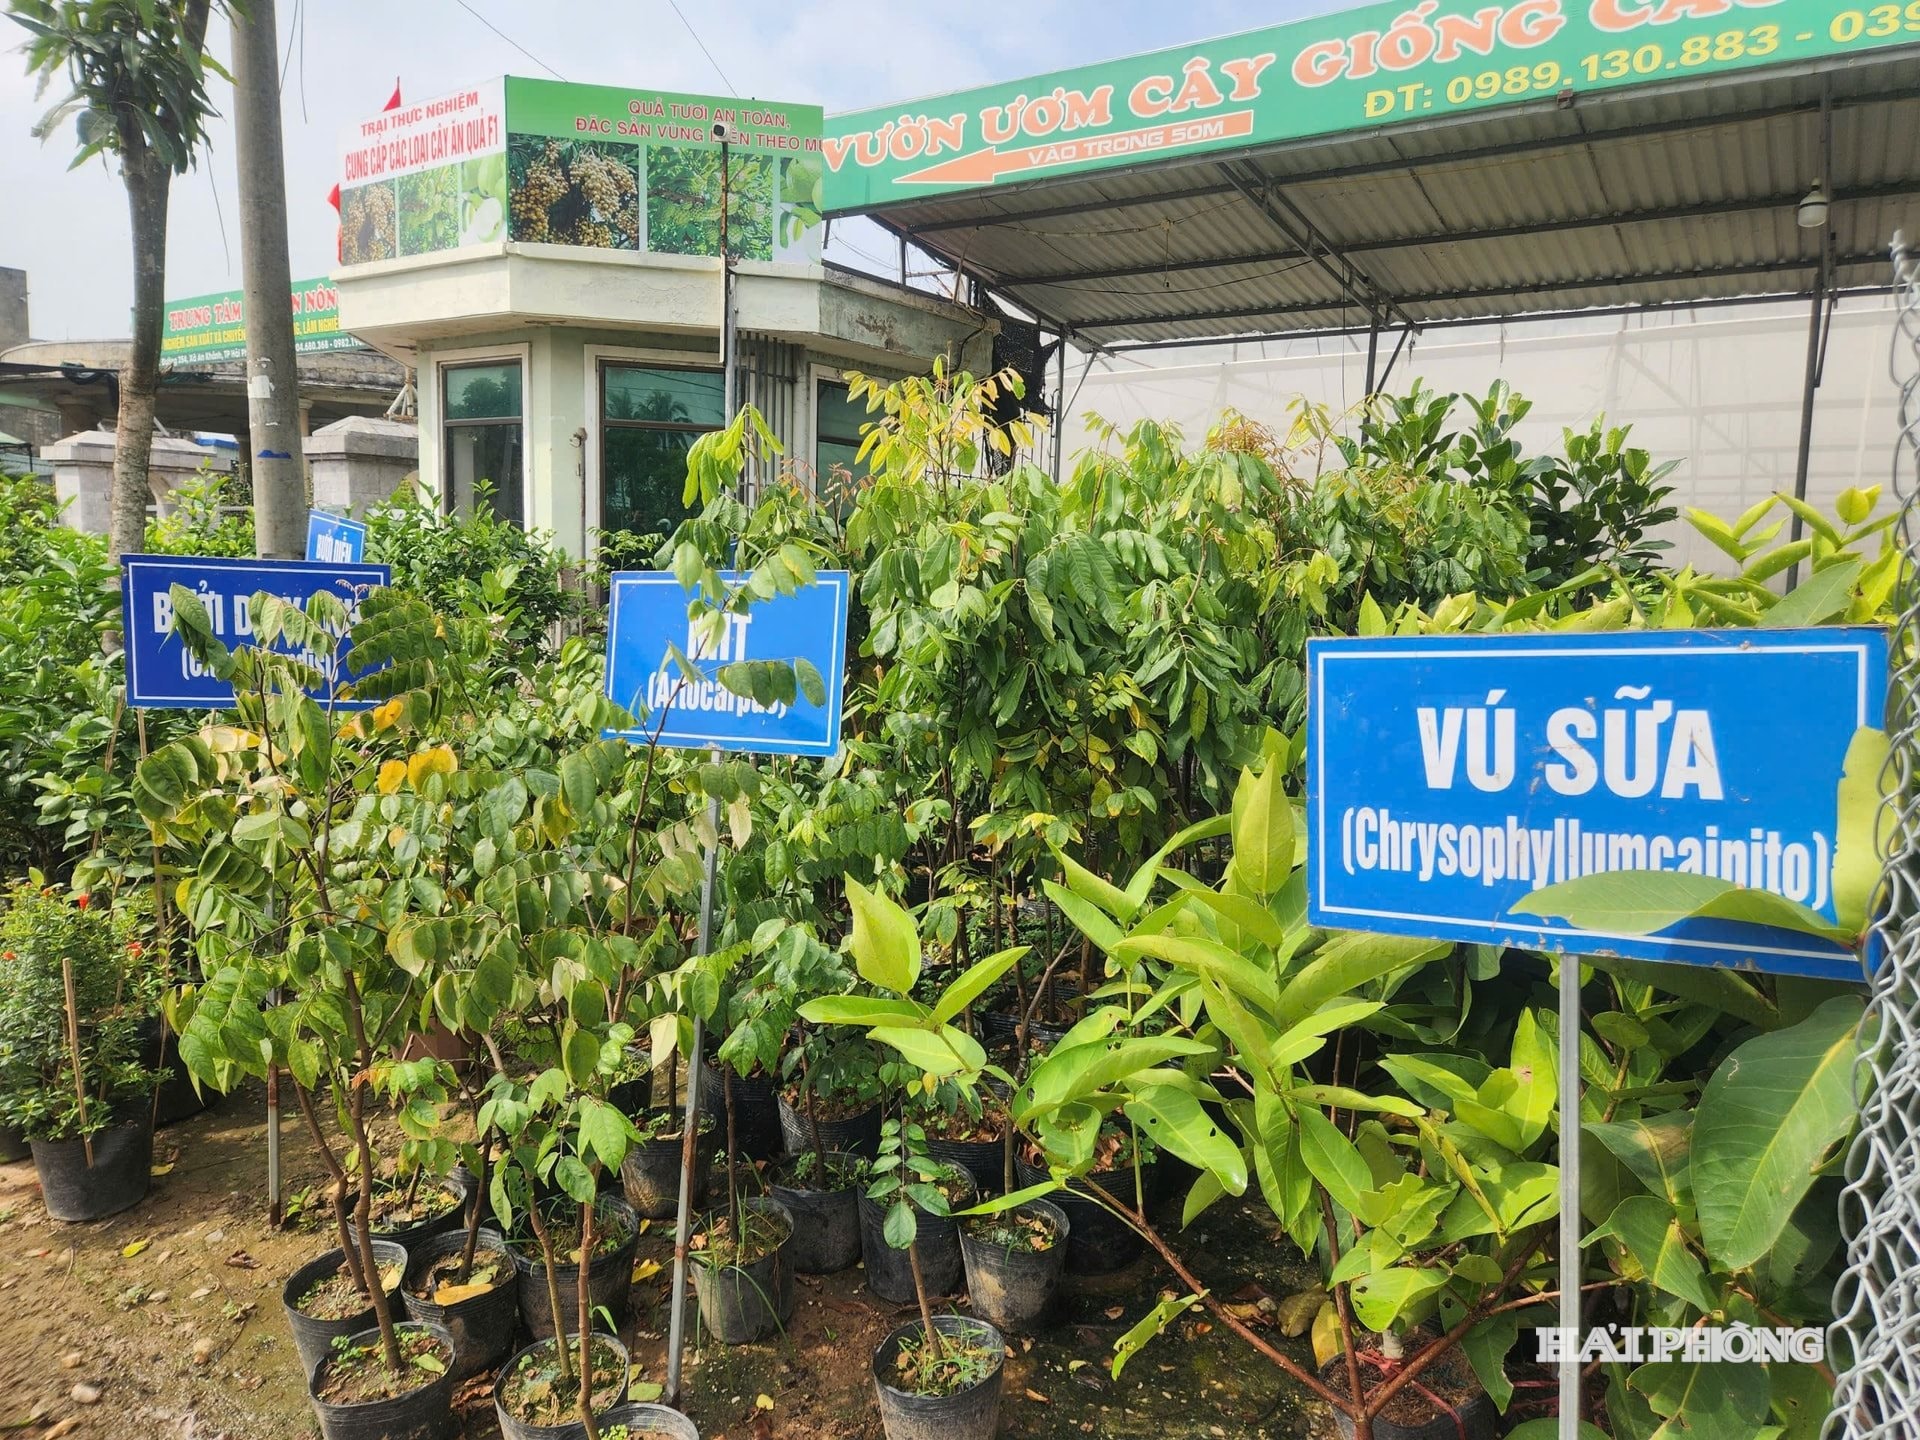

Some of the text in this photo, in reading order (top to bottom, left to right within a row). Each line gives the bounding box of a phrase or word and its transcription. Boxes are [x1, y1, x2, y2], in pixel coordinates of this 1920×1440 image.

[823, 113, 967, 172] VƯỜN
[980, 85, 1114, 144] ƯƠM
[1127, 54, 1276, 119] CÂY
[1292, 0, 1567, 88] GIỐNG
[1363, 83, 1433, 118] ĐT:
[1445, 25, 1779, 105] 0989.130.883
[391, 108, 423, 128] THỰC
[426, 91, 479, 118] NGHIỆM
[576, 115, 611, 136] ĐẶC
[617, 117, 651, 137] SẢN
[657, 121, 704, 142] VÙNG
[755, 133, 800, 150] THEO
[628, 97, 665, 116] QUẢ
[670, 103, 708, 120] TƯƠI
[713, 108, 736, 122] AN
[345, 149, 368, 181] CUNG
[389, 134, 407, 170] CÁC
[409, 132, 429, 169] LOẠI
[431, 123, 449, 160] CÂY
[451, 120, 464, 155] ĂN
[466, 107, 486, 155] QUẢ
[487, 114, 499, 147] F1
[1027, 119, 1225, 168] VÀO TRONG 50M
[169, 297, 242, 331] TRUNG TÂM
[305, 283, 339, 312] NÔN
[152, 579, 225, 636] BỞI
[1416, 684, 1724, 801] VÚ SỮA
